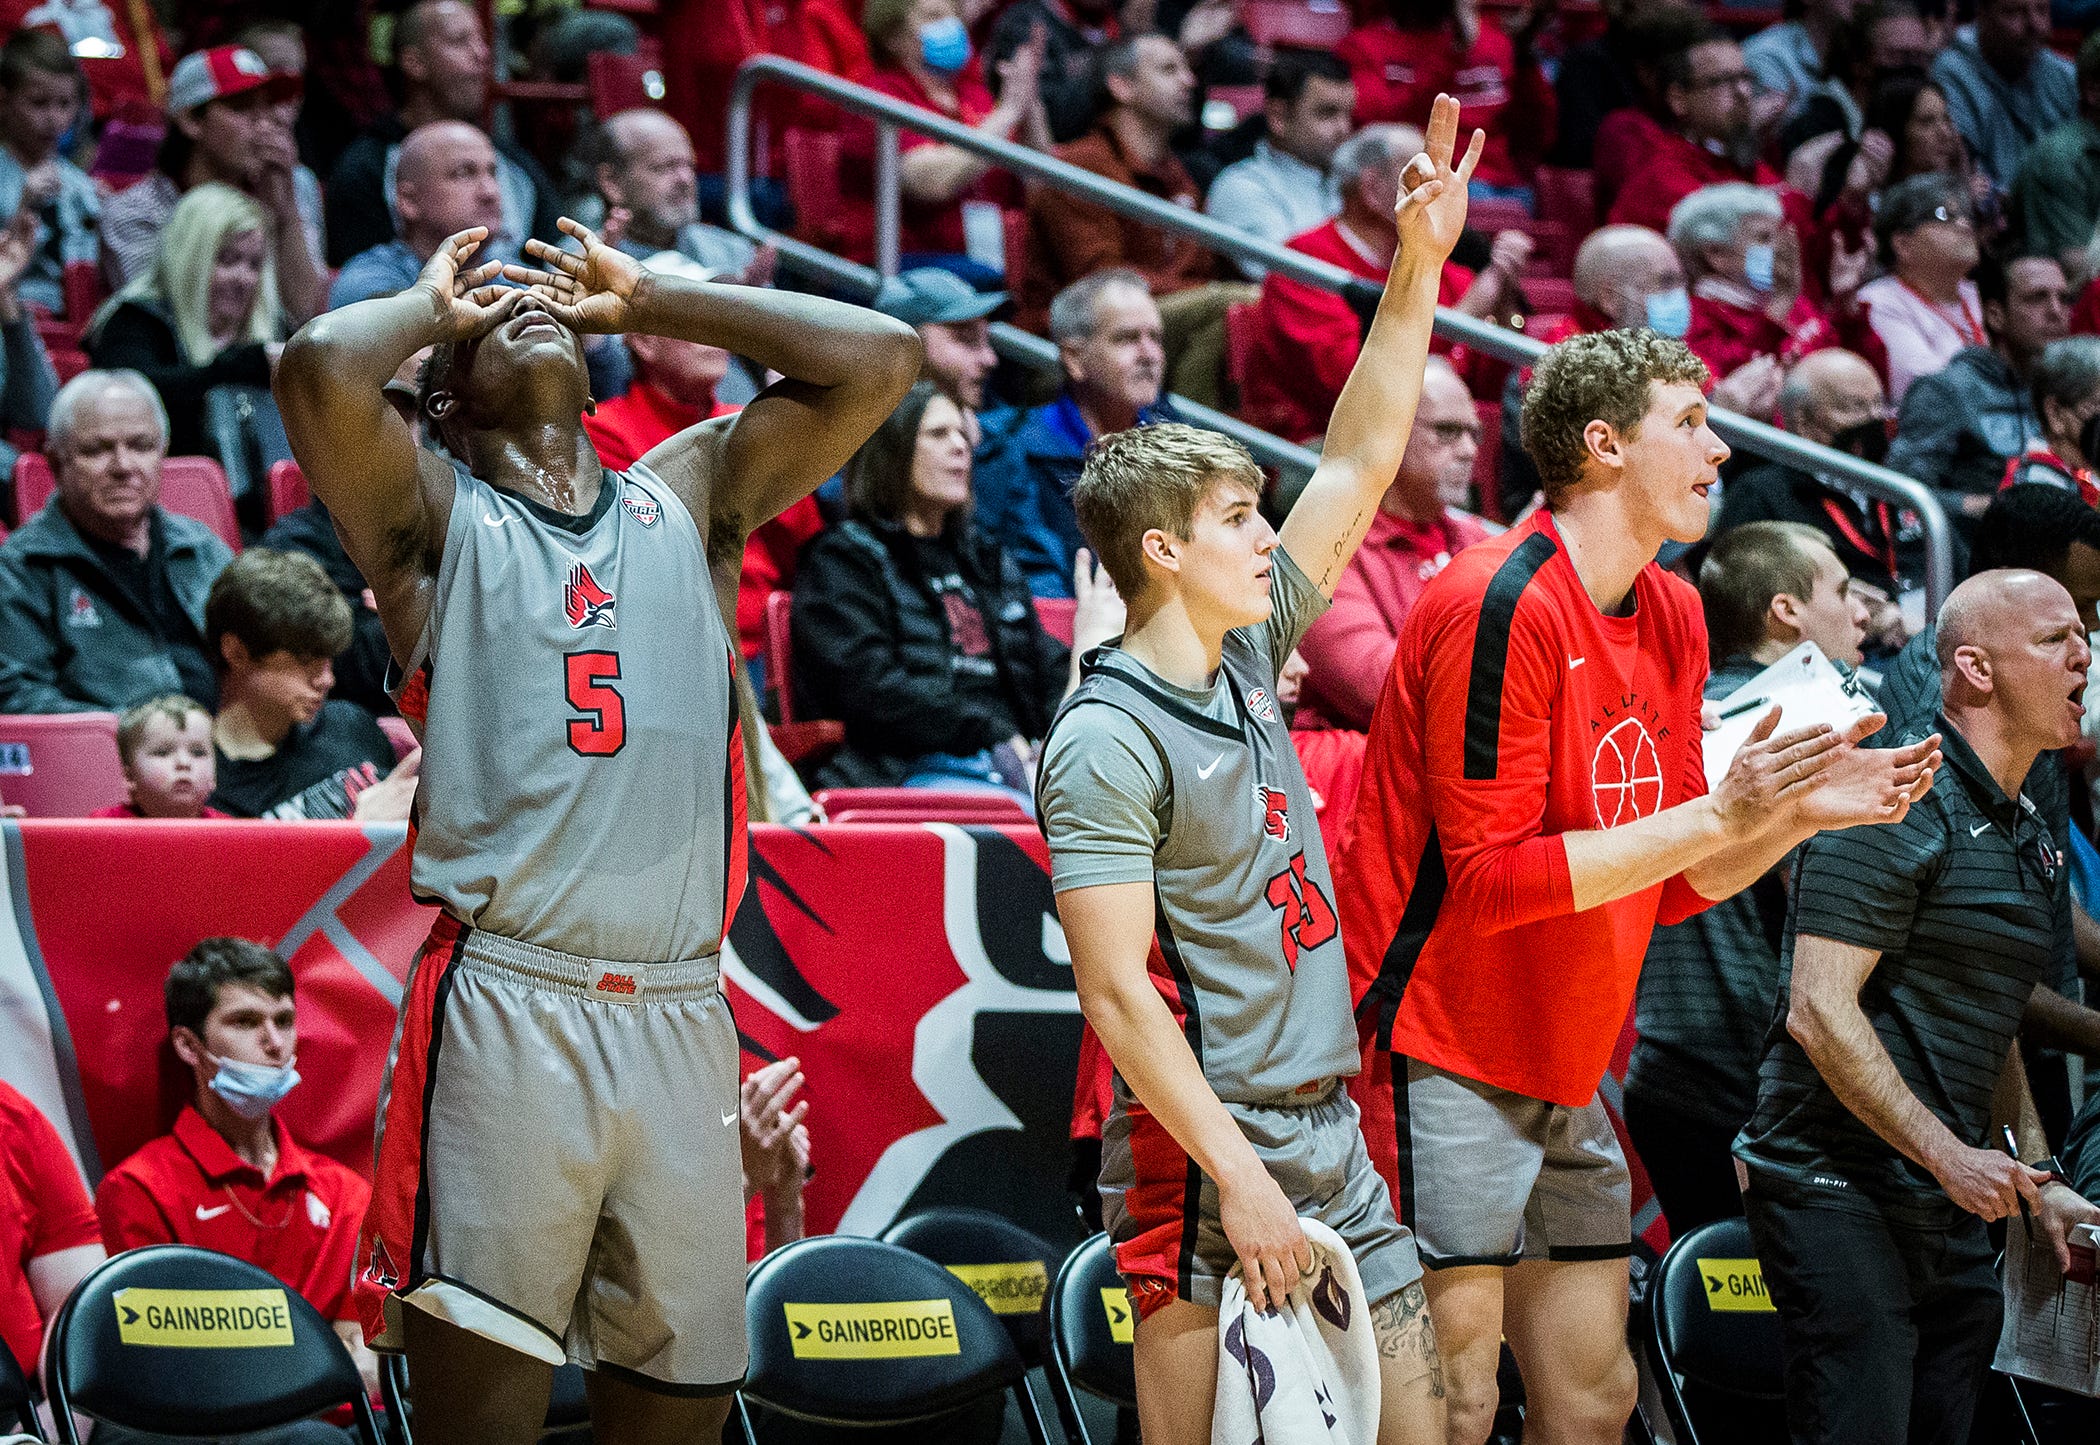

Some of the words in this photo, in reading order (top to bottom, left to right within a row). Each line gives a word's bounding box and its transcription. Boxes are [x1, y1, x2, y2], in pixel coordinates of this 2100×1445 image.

[563, 649, 627, 757] 5
[1264, 847, 1338, 977] 25
[596, 980, 637, 995] STATE
[602, 972, 635, 985] BALL
[1813, 1176, 1848, 1188] DRI-FIT
[146, 1305, 287, 1330] GAINBRIDGE
[817, 1315, 953, 1343] GAINBRIDGE
